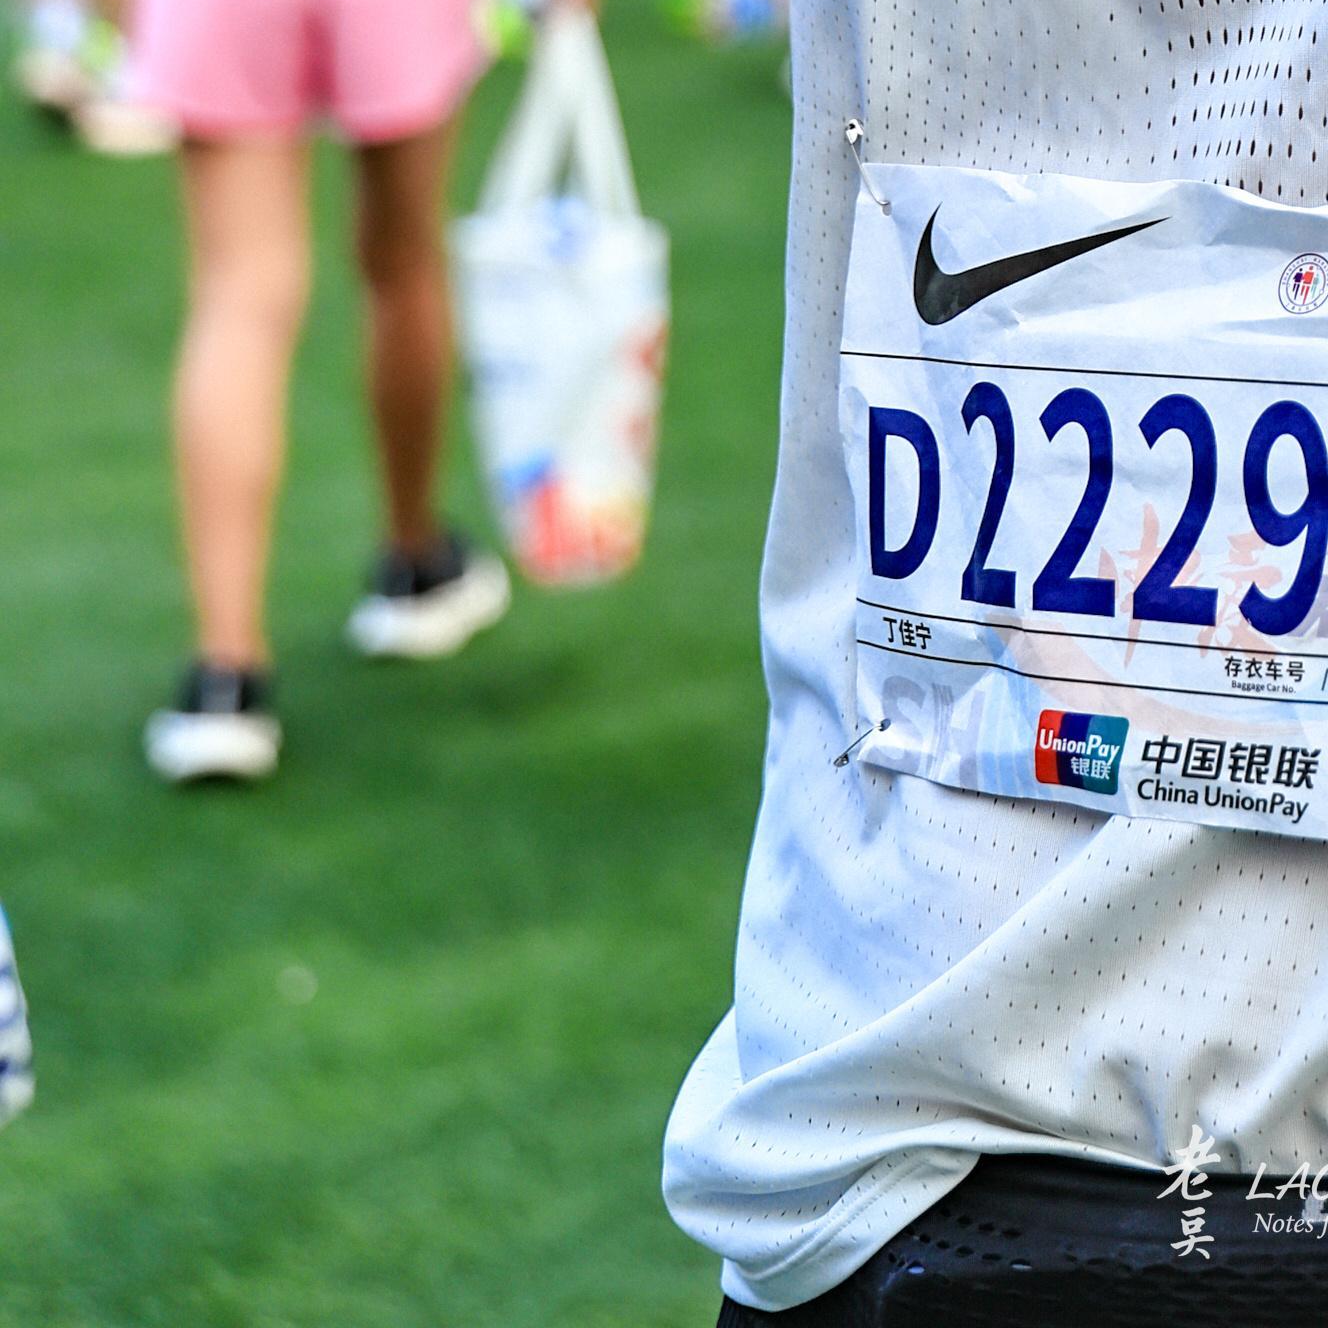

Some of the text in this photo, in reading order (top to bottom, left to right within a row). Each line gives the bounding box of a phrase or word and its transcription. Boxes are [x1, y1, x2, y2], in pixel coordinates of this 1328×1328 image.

[882, 617, 932, 650] 丁佳宁
[1224, 655, 1306, 683] 存衣车号
[1231, 679, 1297, 694] Baggage Car No.
[1039, 728, 1121, 766] UnionPay
[1140, 735, 1321, 790] 中国银联
[1070, 756, 1112, 781] 银联
[1137, 778, 1309, 824] China UnionPay
